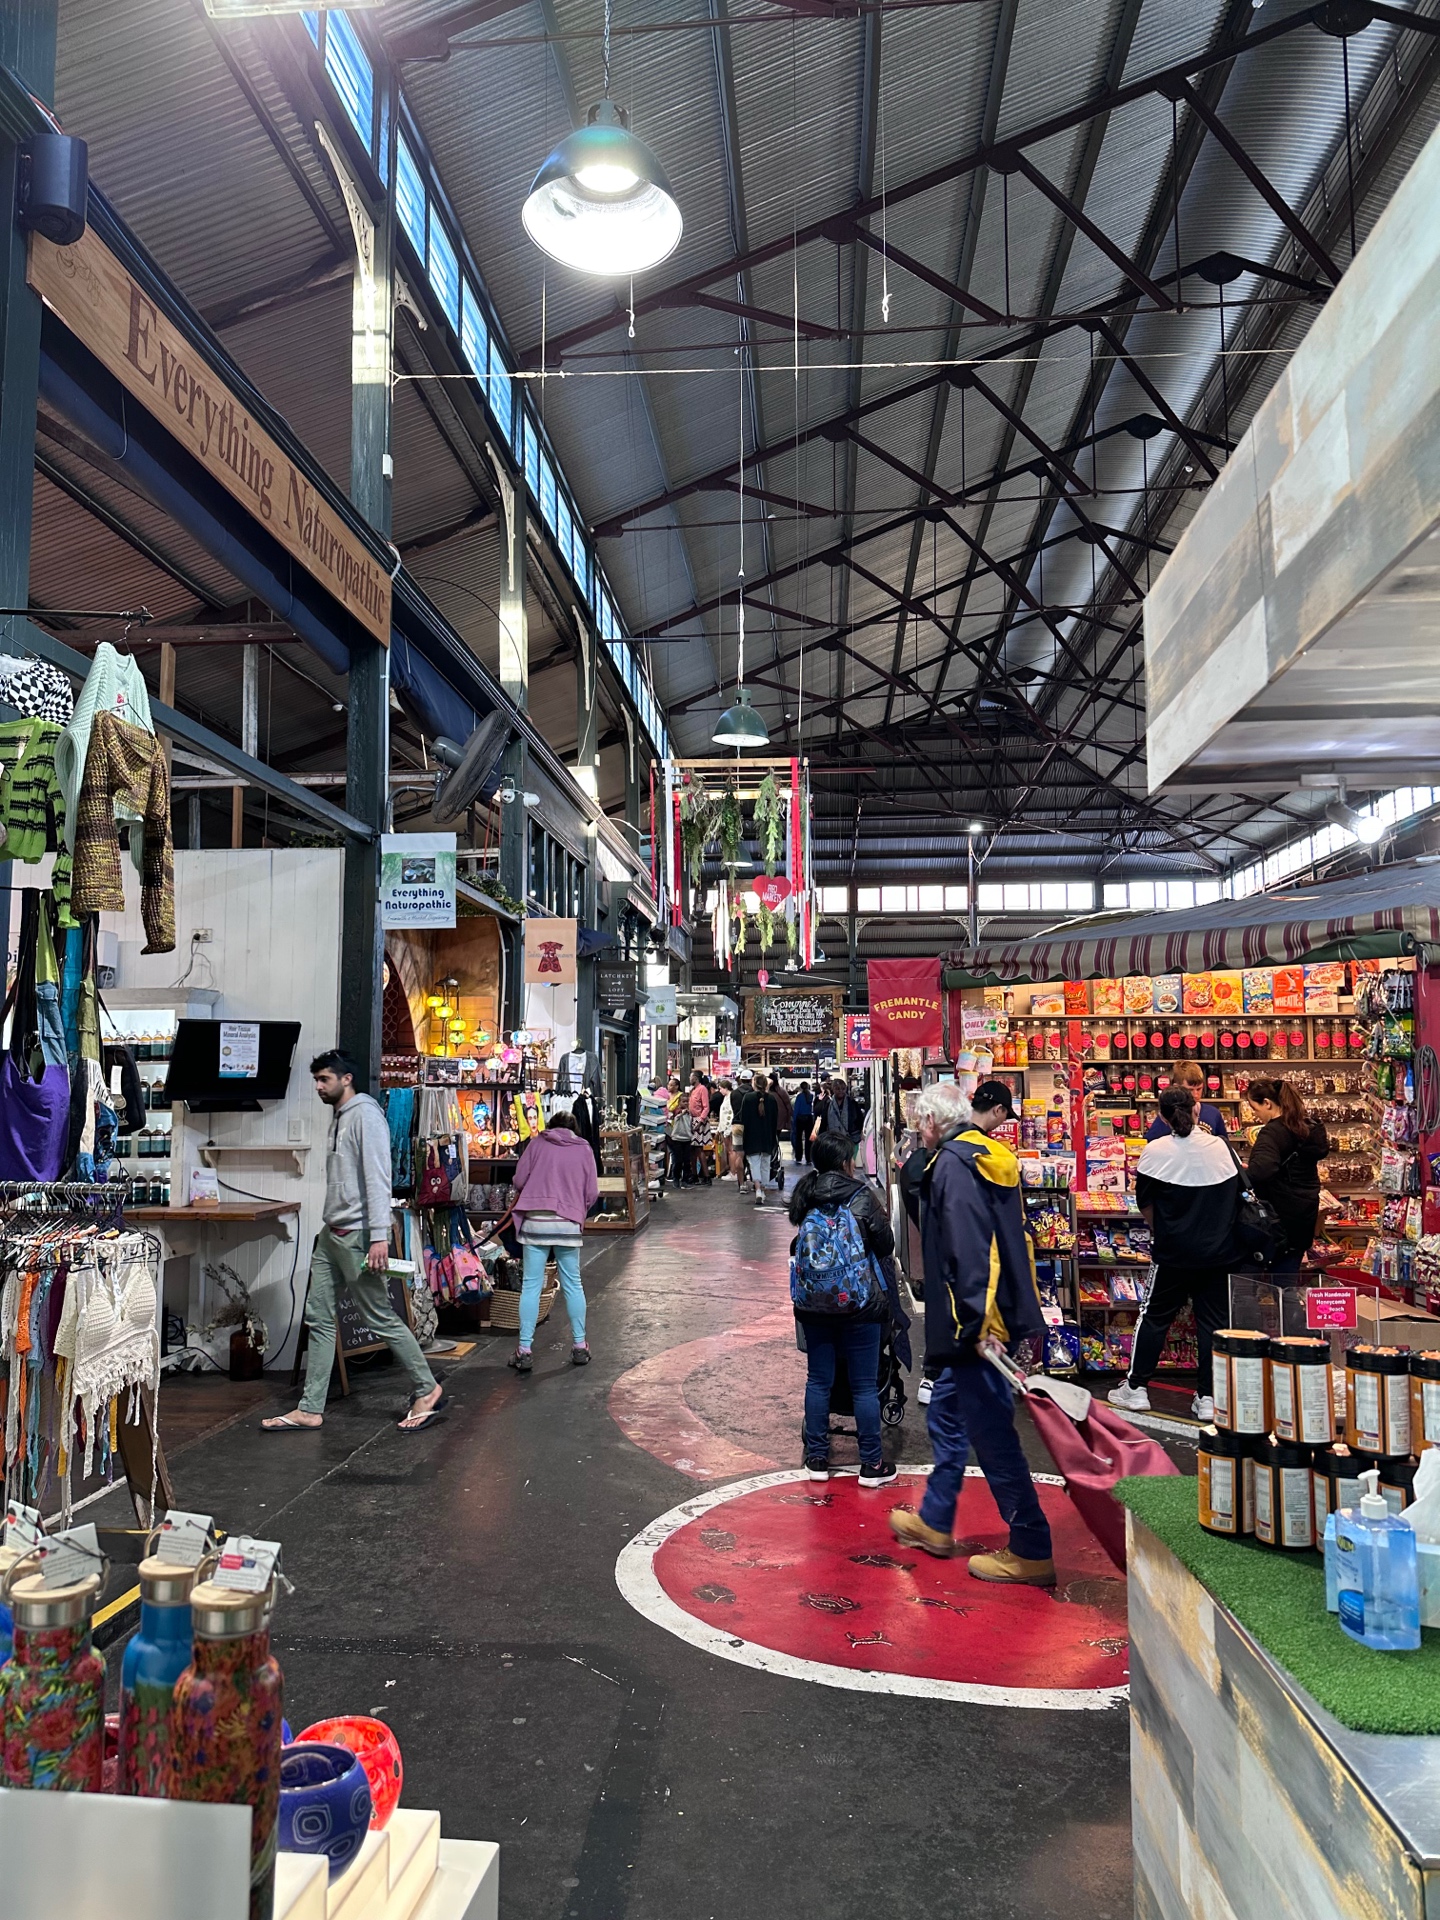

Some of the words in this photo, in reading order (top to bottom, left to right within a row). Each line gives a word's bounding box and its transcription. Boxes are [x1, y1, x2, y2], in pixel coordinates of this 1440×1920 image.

[121, 275, 275, 521] Everything
[283, 464, 387, 627] Naturopathic
[392, 888, 445, 899] Everything
[385, 900, 452, 911] Naturopathic
[873, 996, 939, 1012] FREMANTLE
[888, 1010, 927, 1021] CANDY
[965, 1020, 985, 1029] ONLY
[822, 1267, 848, 1280] MICKEY
